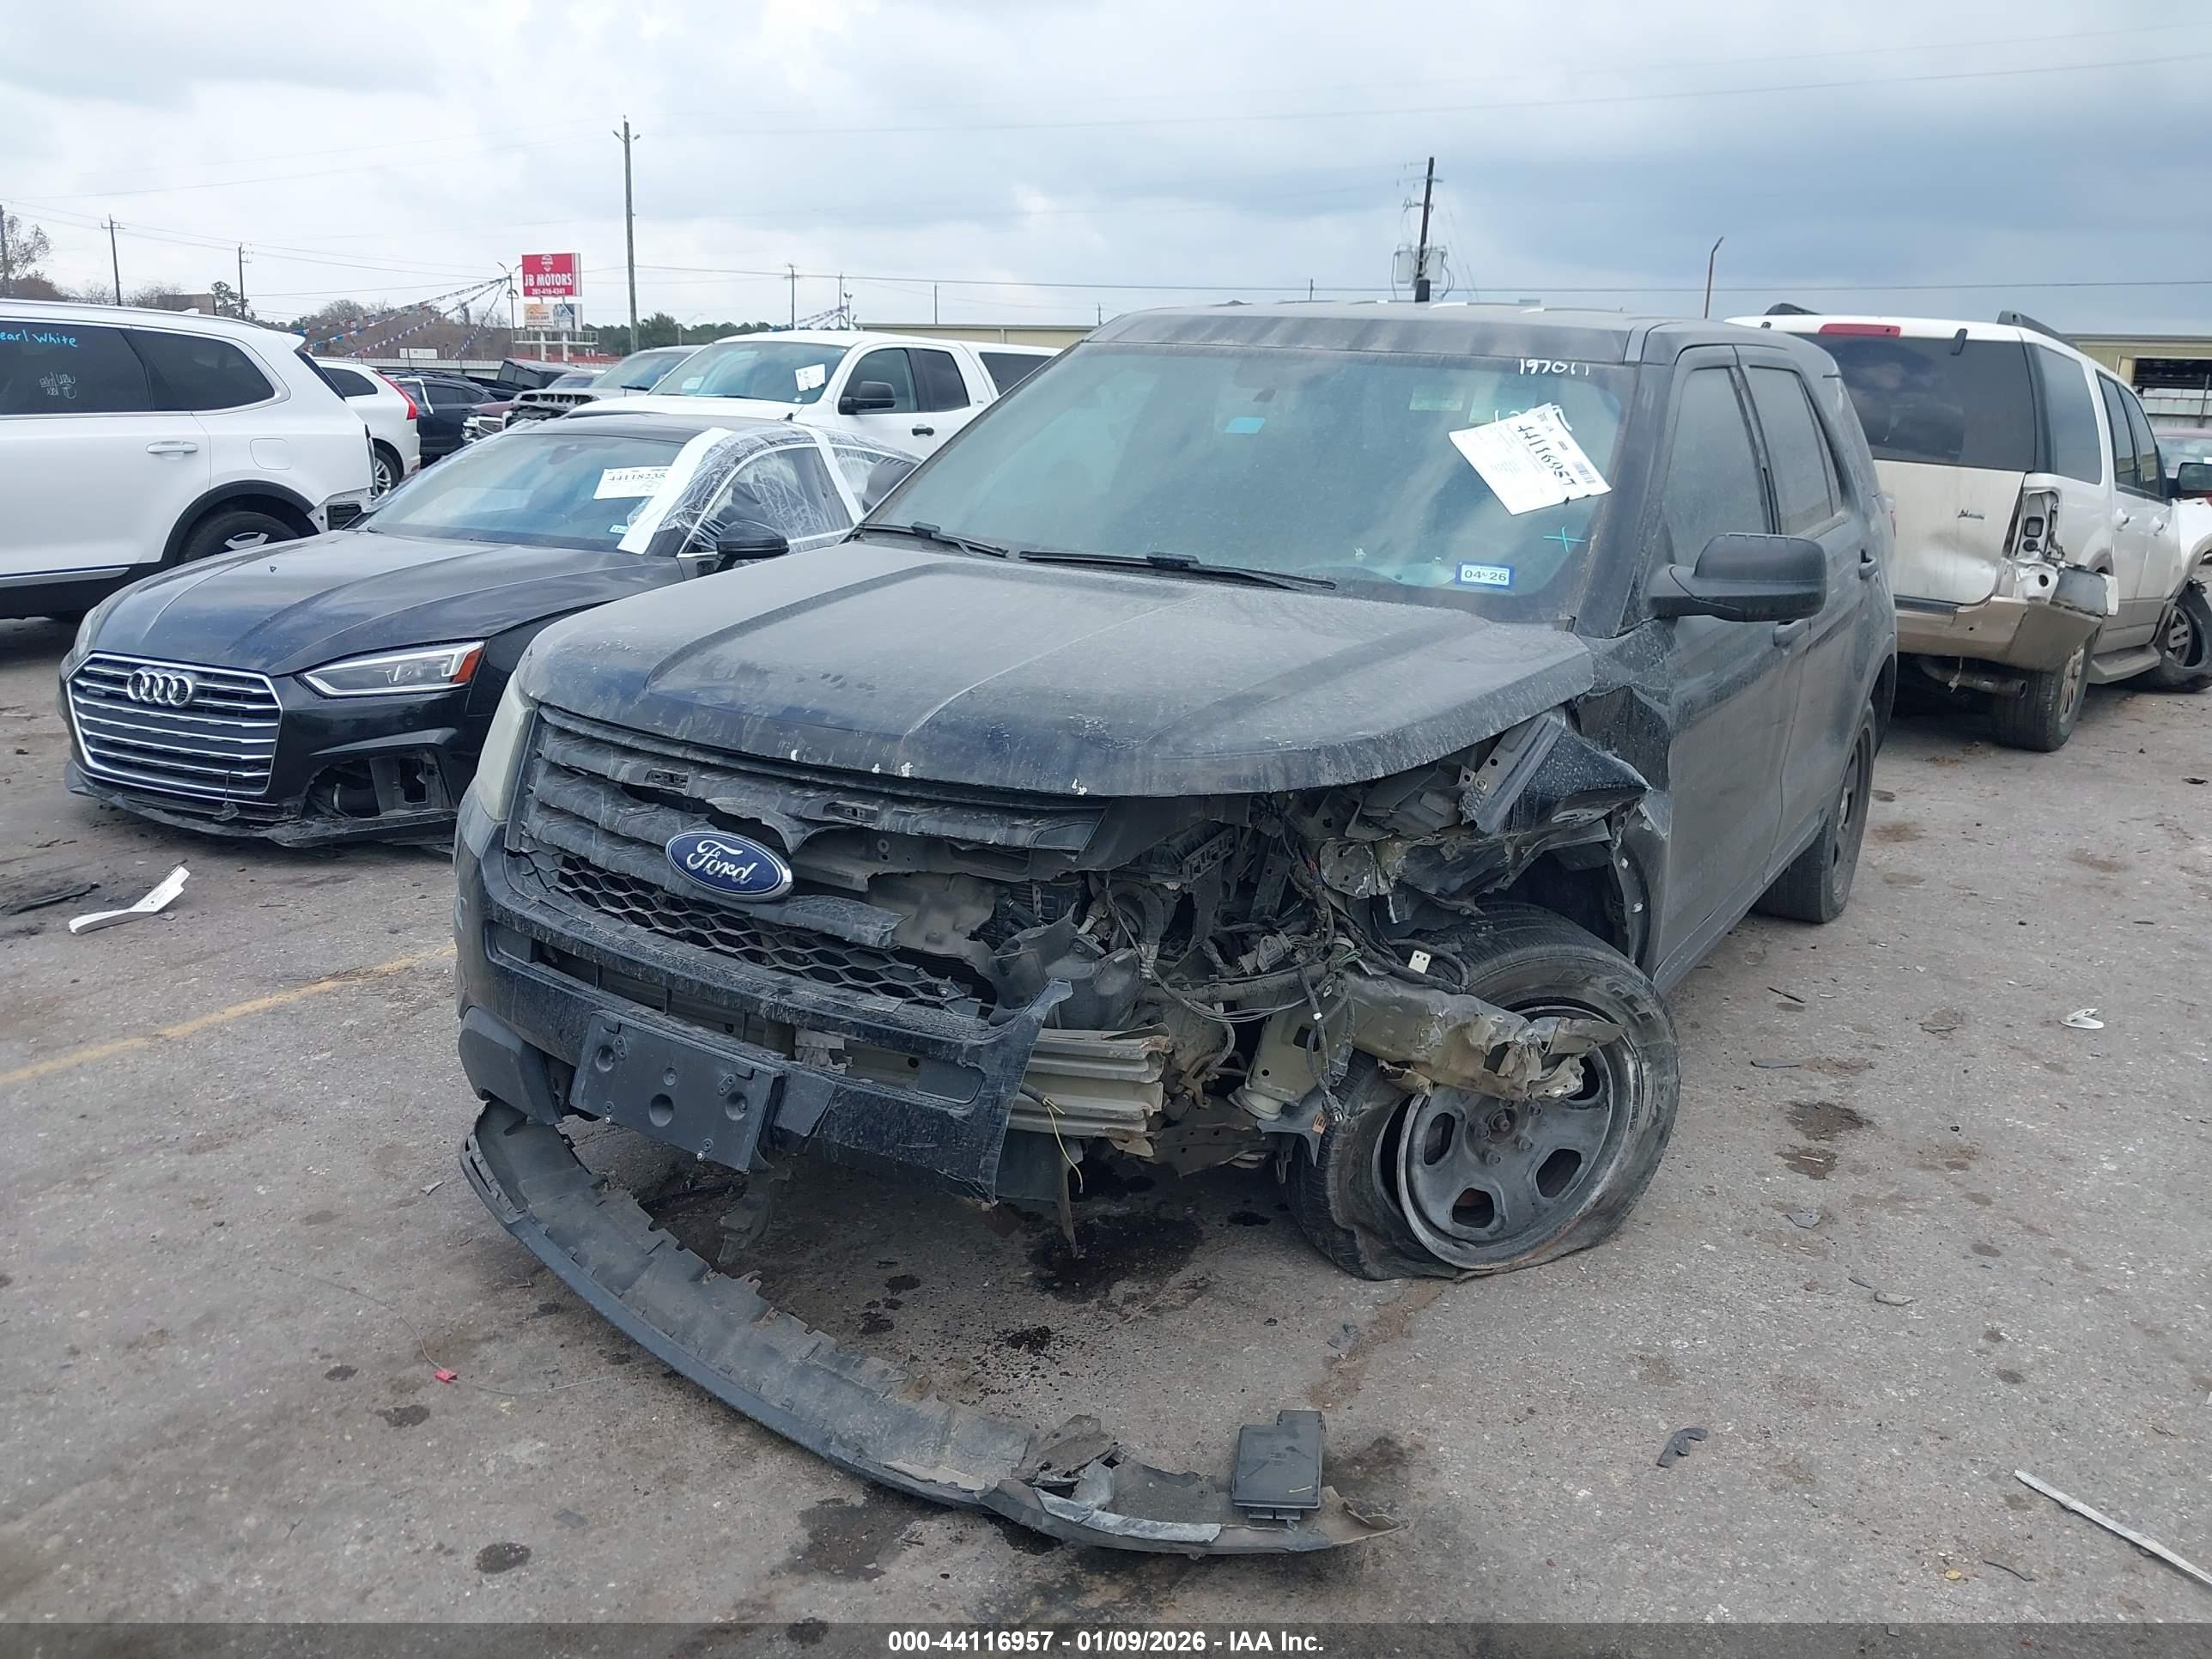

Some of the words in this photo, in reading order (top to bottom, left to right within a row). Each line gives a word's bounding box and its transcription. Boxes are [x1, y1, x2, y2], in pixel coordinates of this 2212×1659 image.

[525, 274, 534, 287] JB
[537, 273, 572, 286] MOTORS
[1489, 572, 1506, 581] 26
[686, 839, 758, 885] Ford
